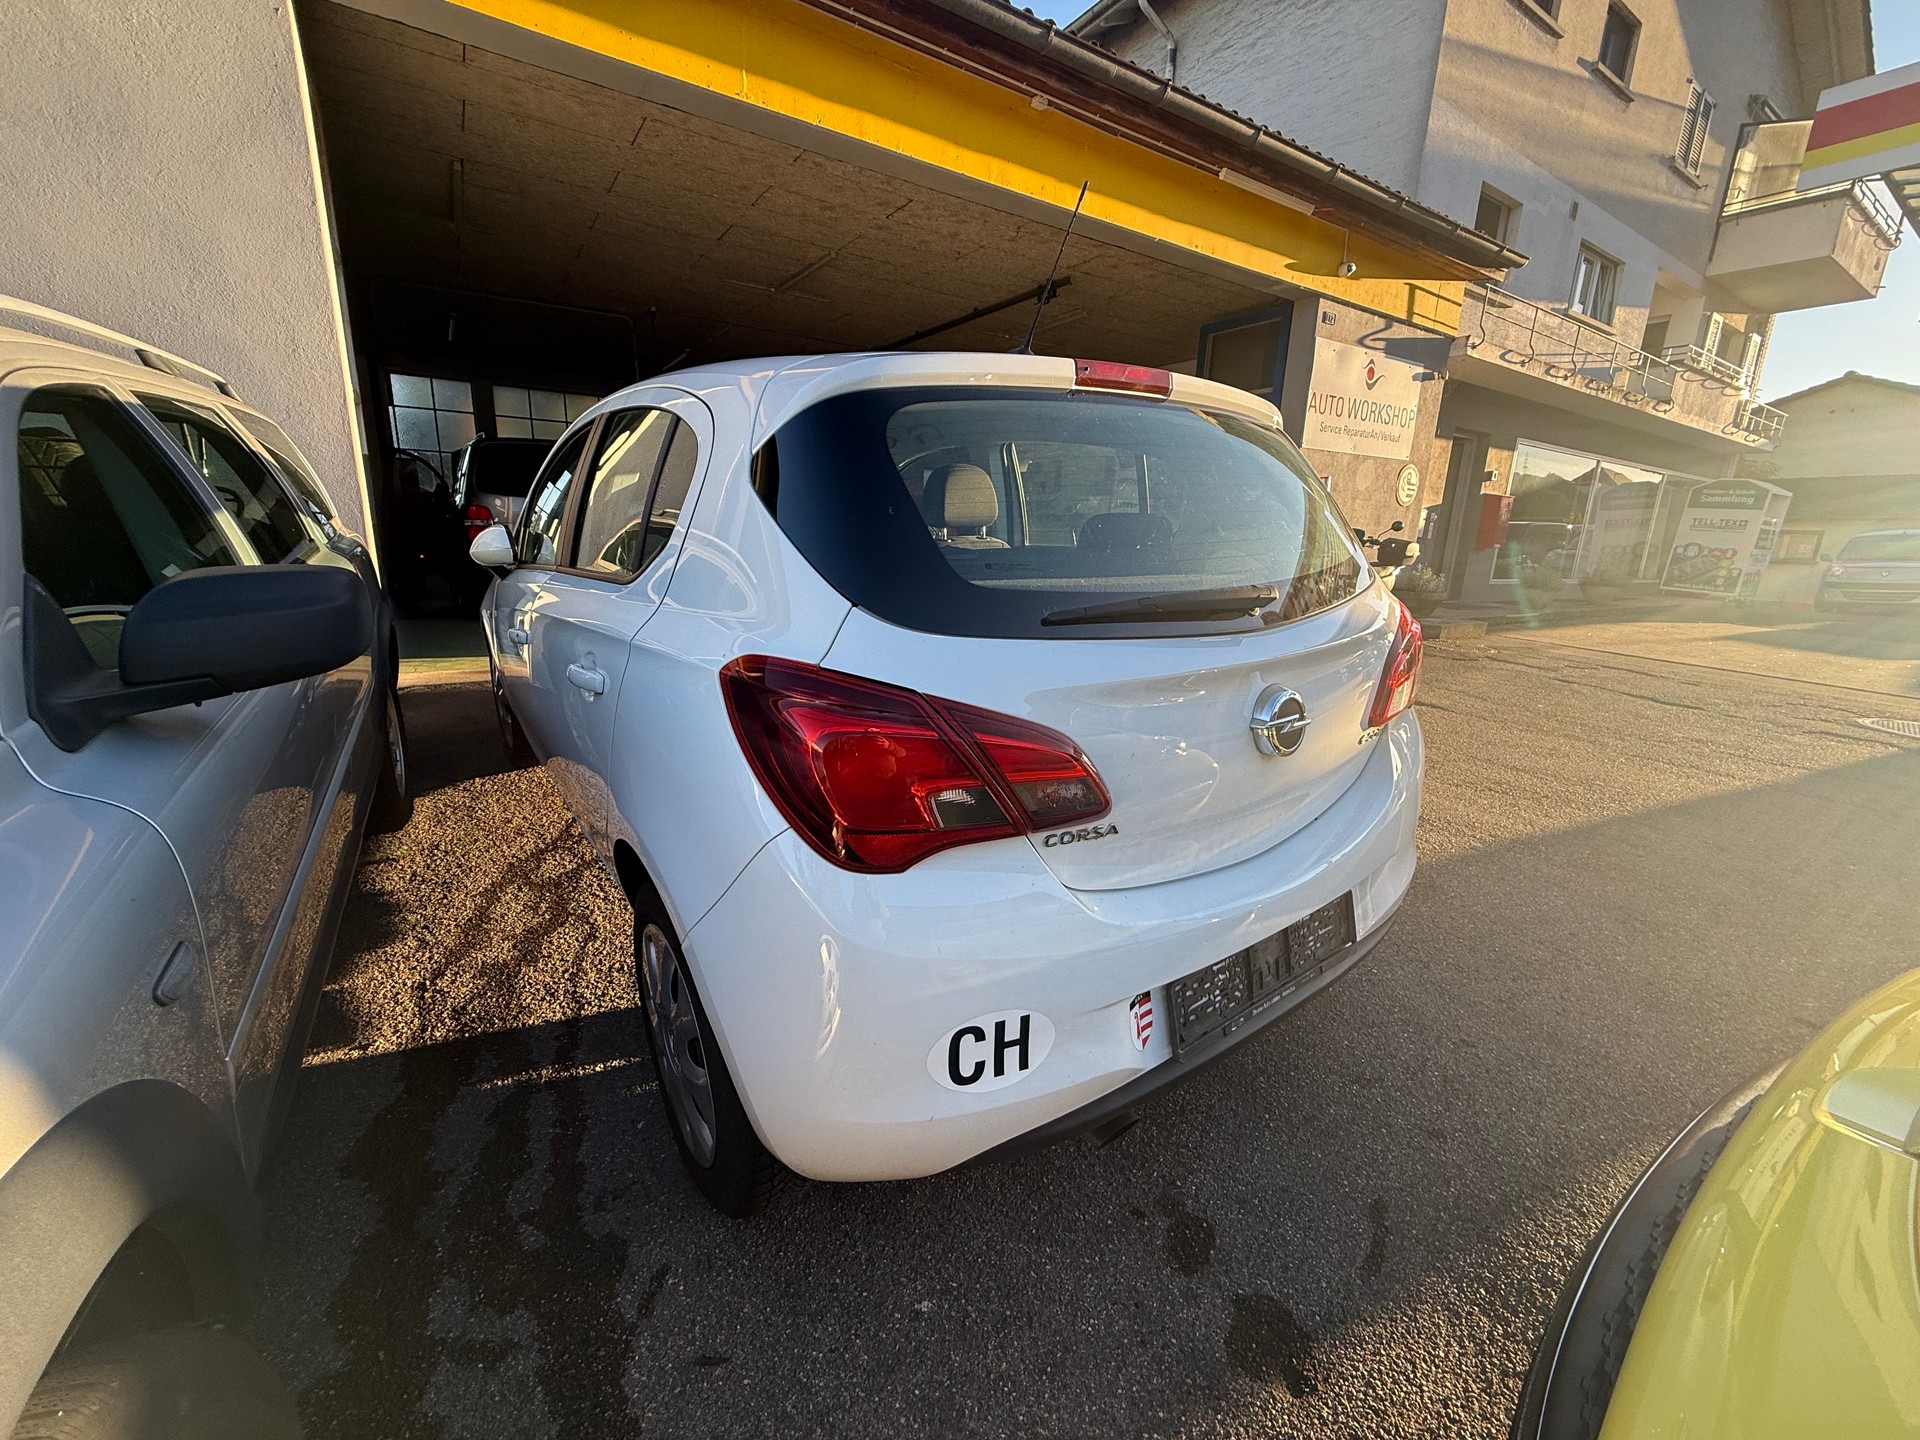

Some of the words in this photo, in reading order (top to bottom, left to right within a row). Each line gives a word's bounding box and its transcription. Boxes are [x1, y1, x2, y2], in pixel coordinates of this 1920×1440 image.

[1308, 392, 1345, 417] AUTO
[1347, 397, 1415, 429] WORKSHOP
[1320, 421, 1342, 434] Service
[1700, 494, 1755, 505] Sammlung
[1692, 517, 1739, 526] TELL-TEX
[1043, 822, 1119, 848] CORSA
[948, 1014, 1031, 1086] CH
